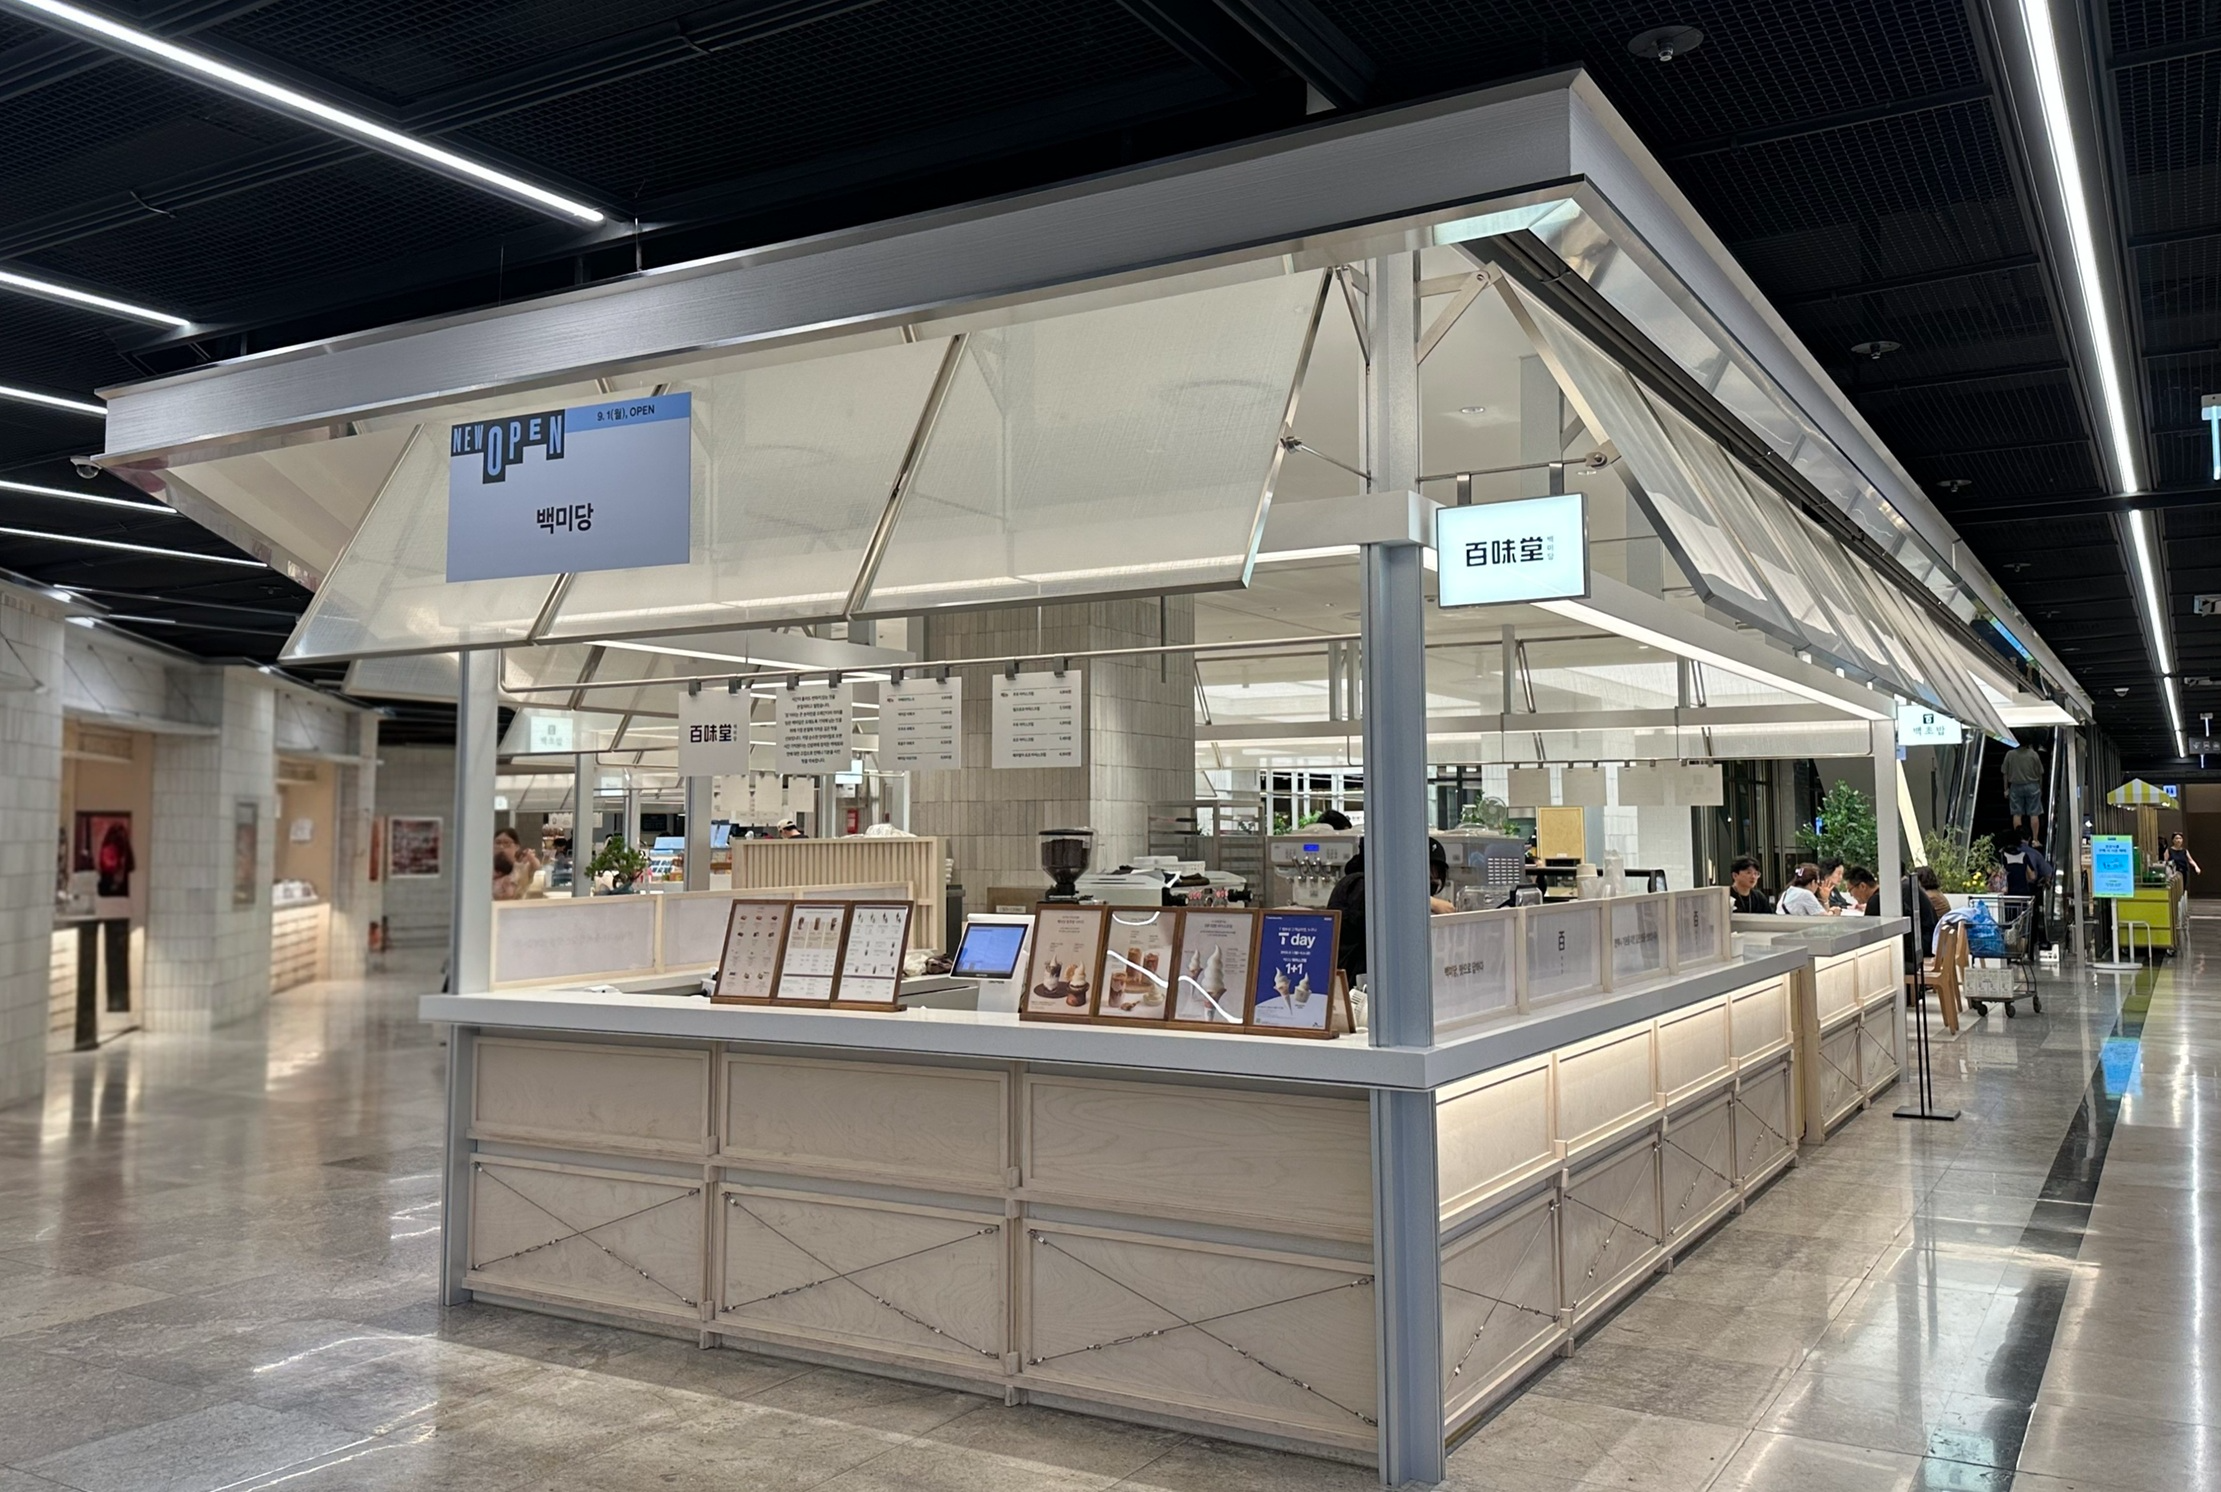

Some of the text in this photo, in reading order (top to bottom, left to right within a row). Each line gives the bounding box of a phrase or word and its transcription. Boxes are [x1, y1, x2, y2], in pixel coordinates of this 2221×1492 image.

[630, 404, 655, 417] OPEN
[453, 415, 562, 476] NEW OPEN
[536, 503, 594, 535] 백미당
[1465, 536, 1544, 567] 百味堂
[690, 723, 732, 743] 百味堂
[1278, 932, 1316, 949] T day
[1285, 963, 1303, 975] 1+1
